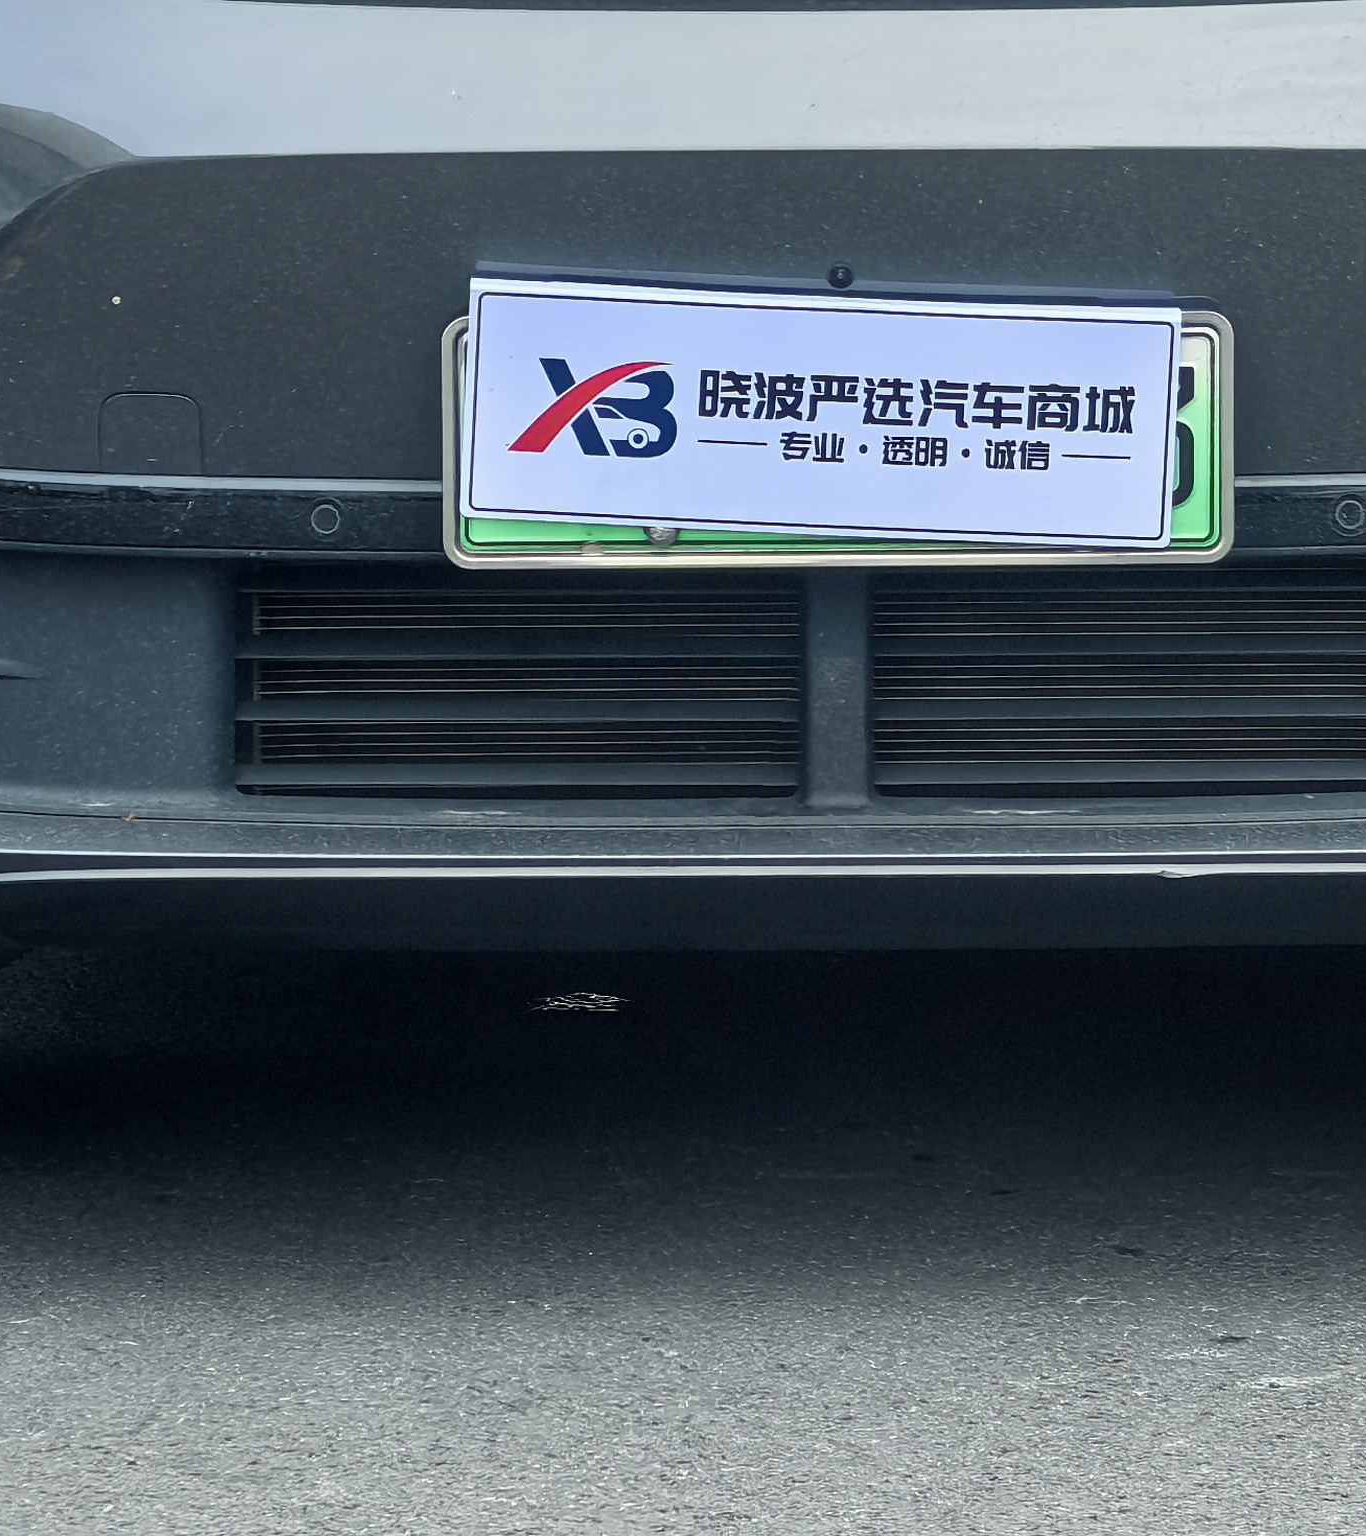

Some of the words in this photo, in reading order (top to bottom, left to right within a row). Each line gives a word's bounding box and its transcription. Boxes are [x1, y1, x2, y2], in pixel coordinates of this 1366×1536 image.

[697, 369, 1136, 435] 晓波严选汽车商城
